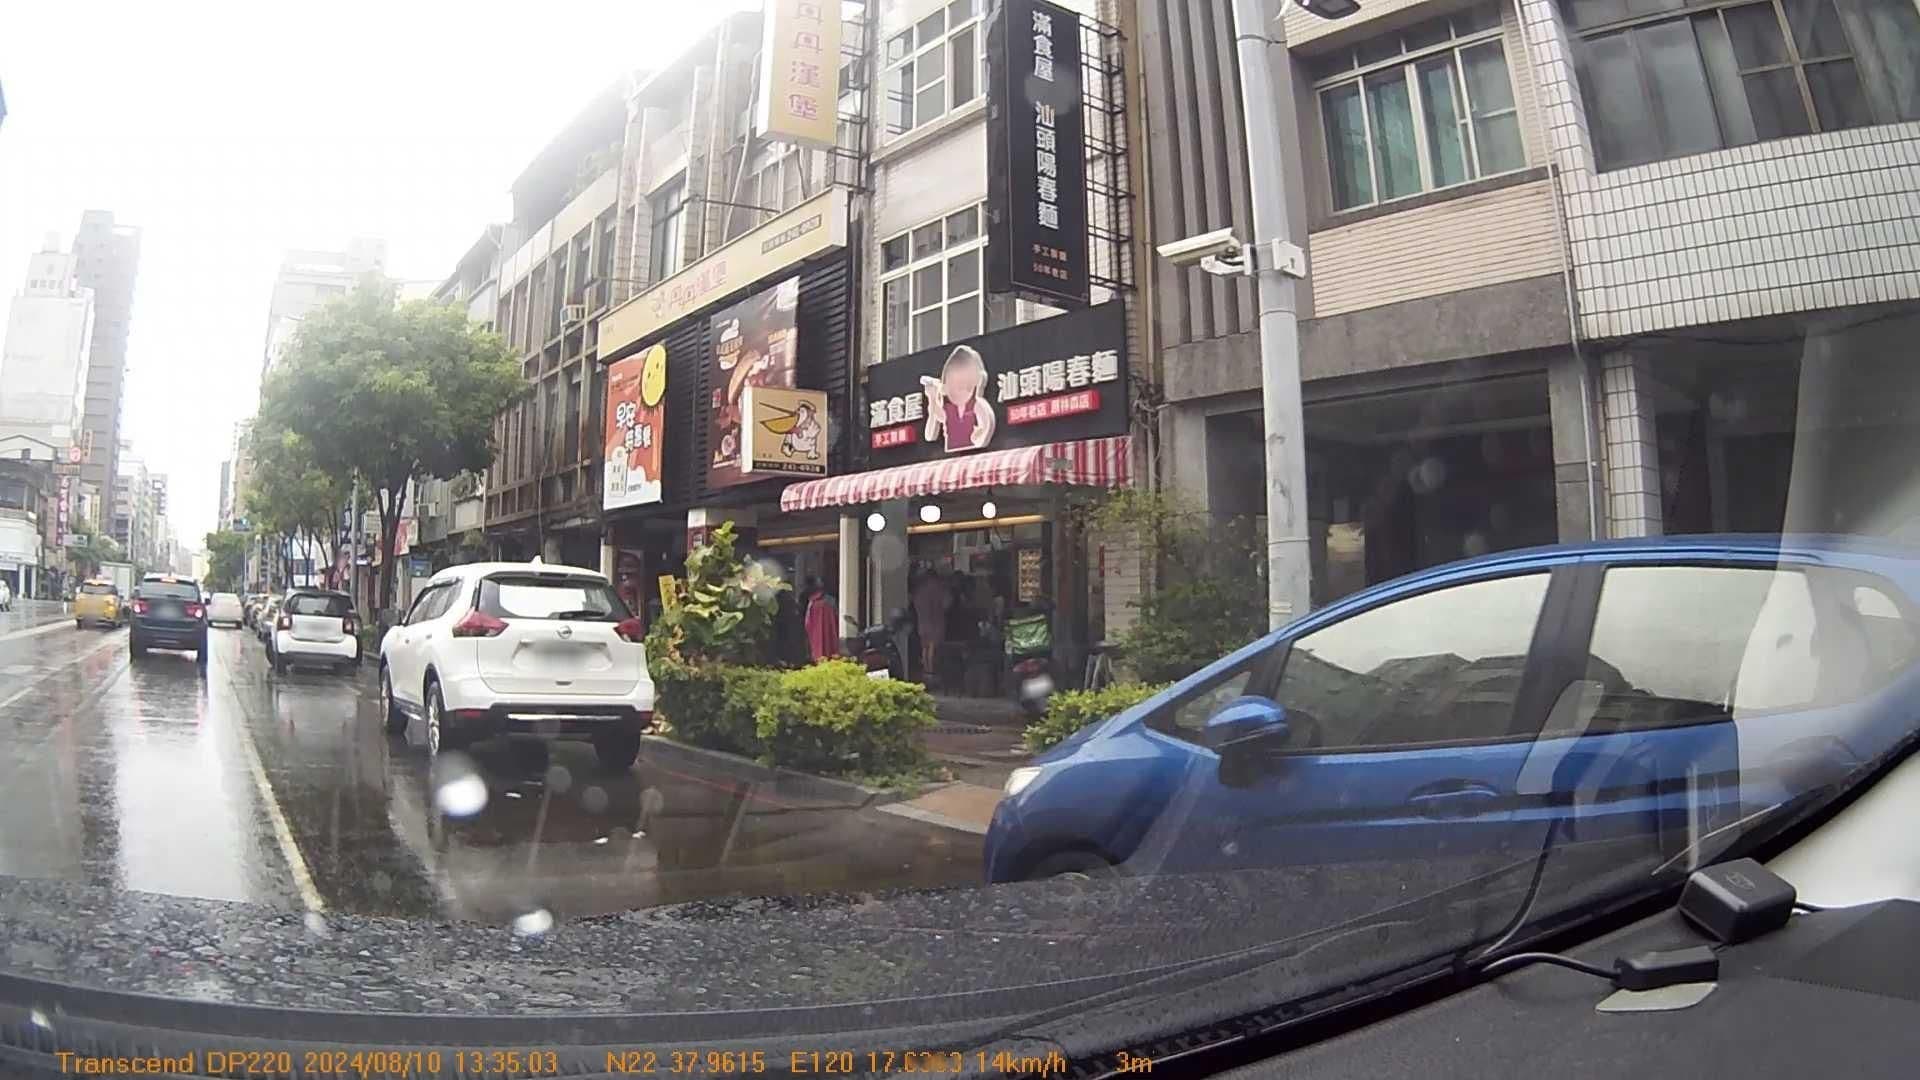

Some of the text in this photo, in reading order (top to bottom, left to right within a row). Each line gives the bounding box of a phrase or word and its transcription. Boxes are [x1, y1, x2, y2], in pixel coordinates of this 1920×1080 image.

[1032, 9, 1059, 230] 滿食屋 汕頭陽春麵
[870, 350, 1118, 428] 滿食屋 汕頭陽春麵
